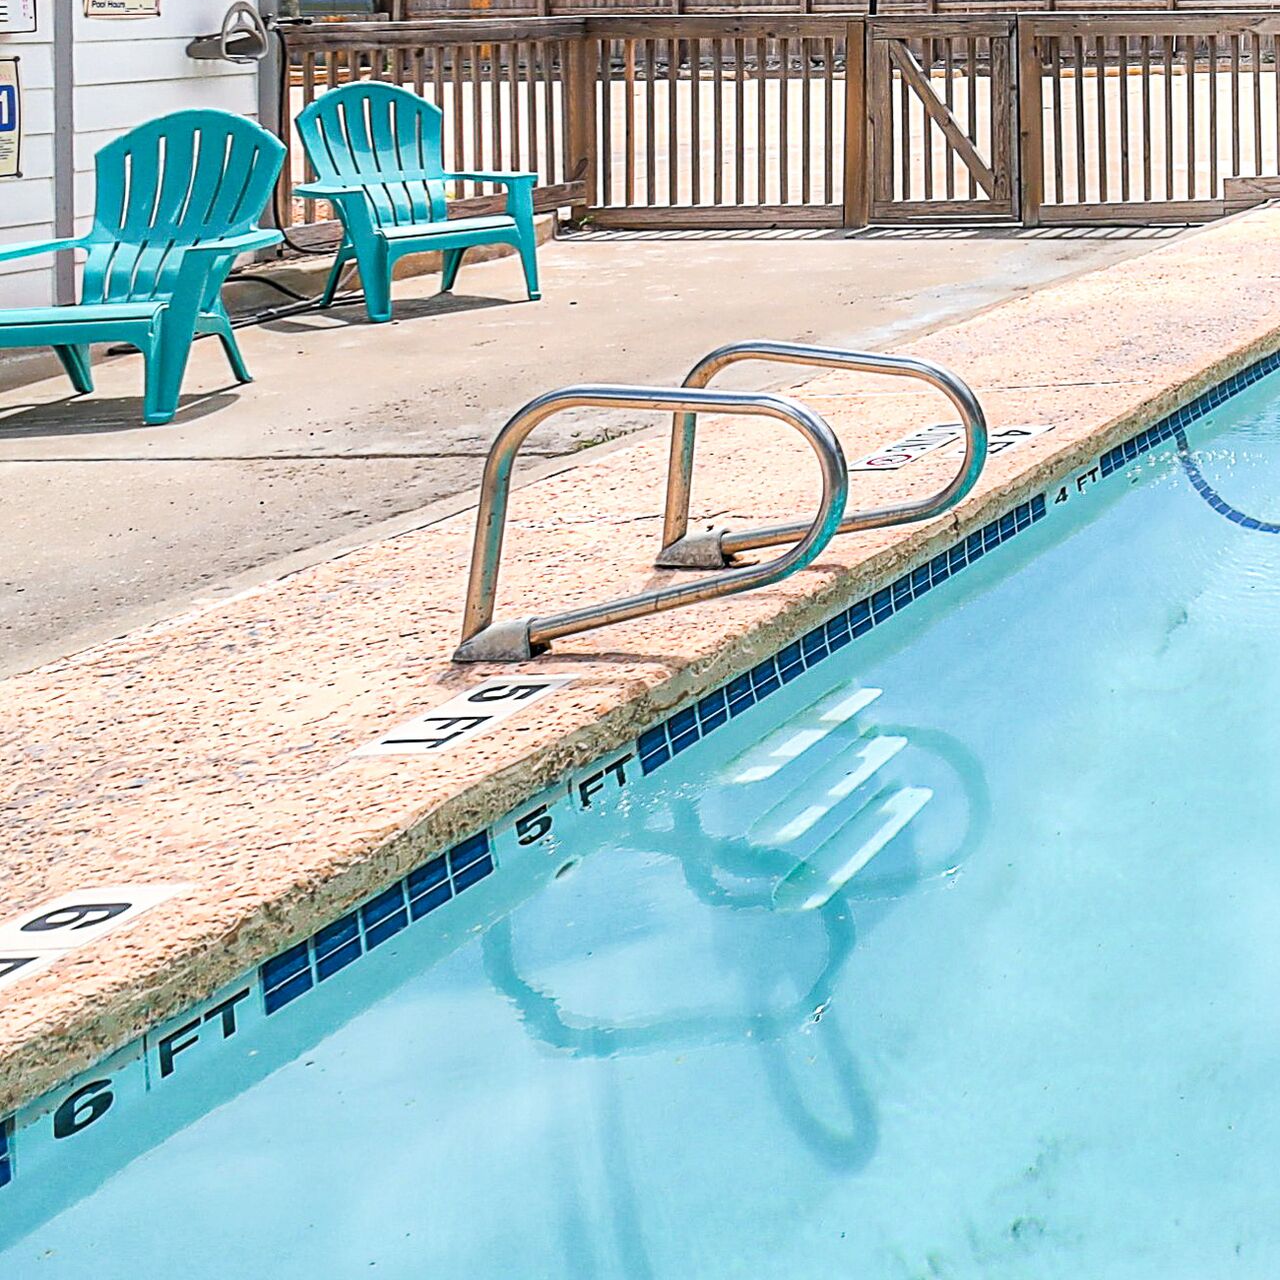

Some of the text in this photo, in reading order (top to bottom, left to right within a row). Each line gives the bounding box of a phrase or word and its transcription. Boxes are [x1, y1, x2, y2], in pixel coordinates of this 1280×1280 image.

[1054, 466, 1099, 504] 4 FT
[380, 684, 550, 749] 5 FT
[515, 753, 633, 846] 5 FT
[20, 902, 133, 932] 6
[53, 986, 250, 1139] 6 FT
